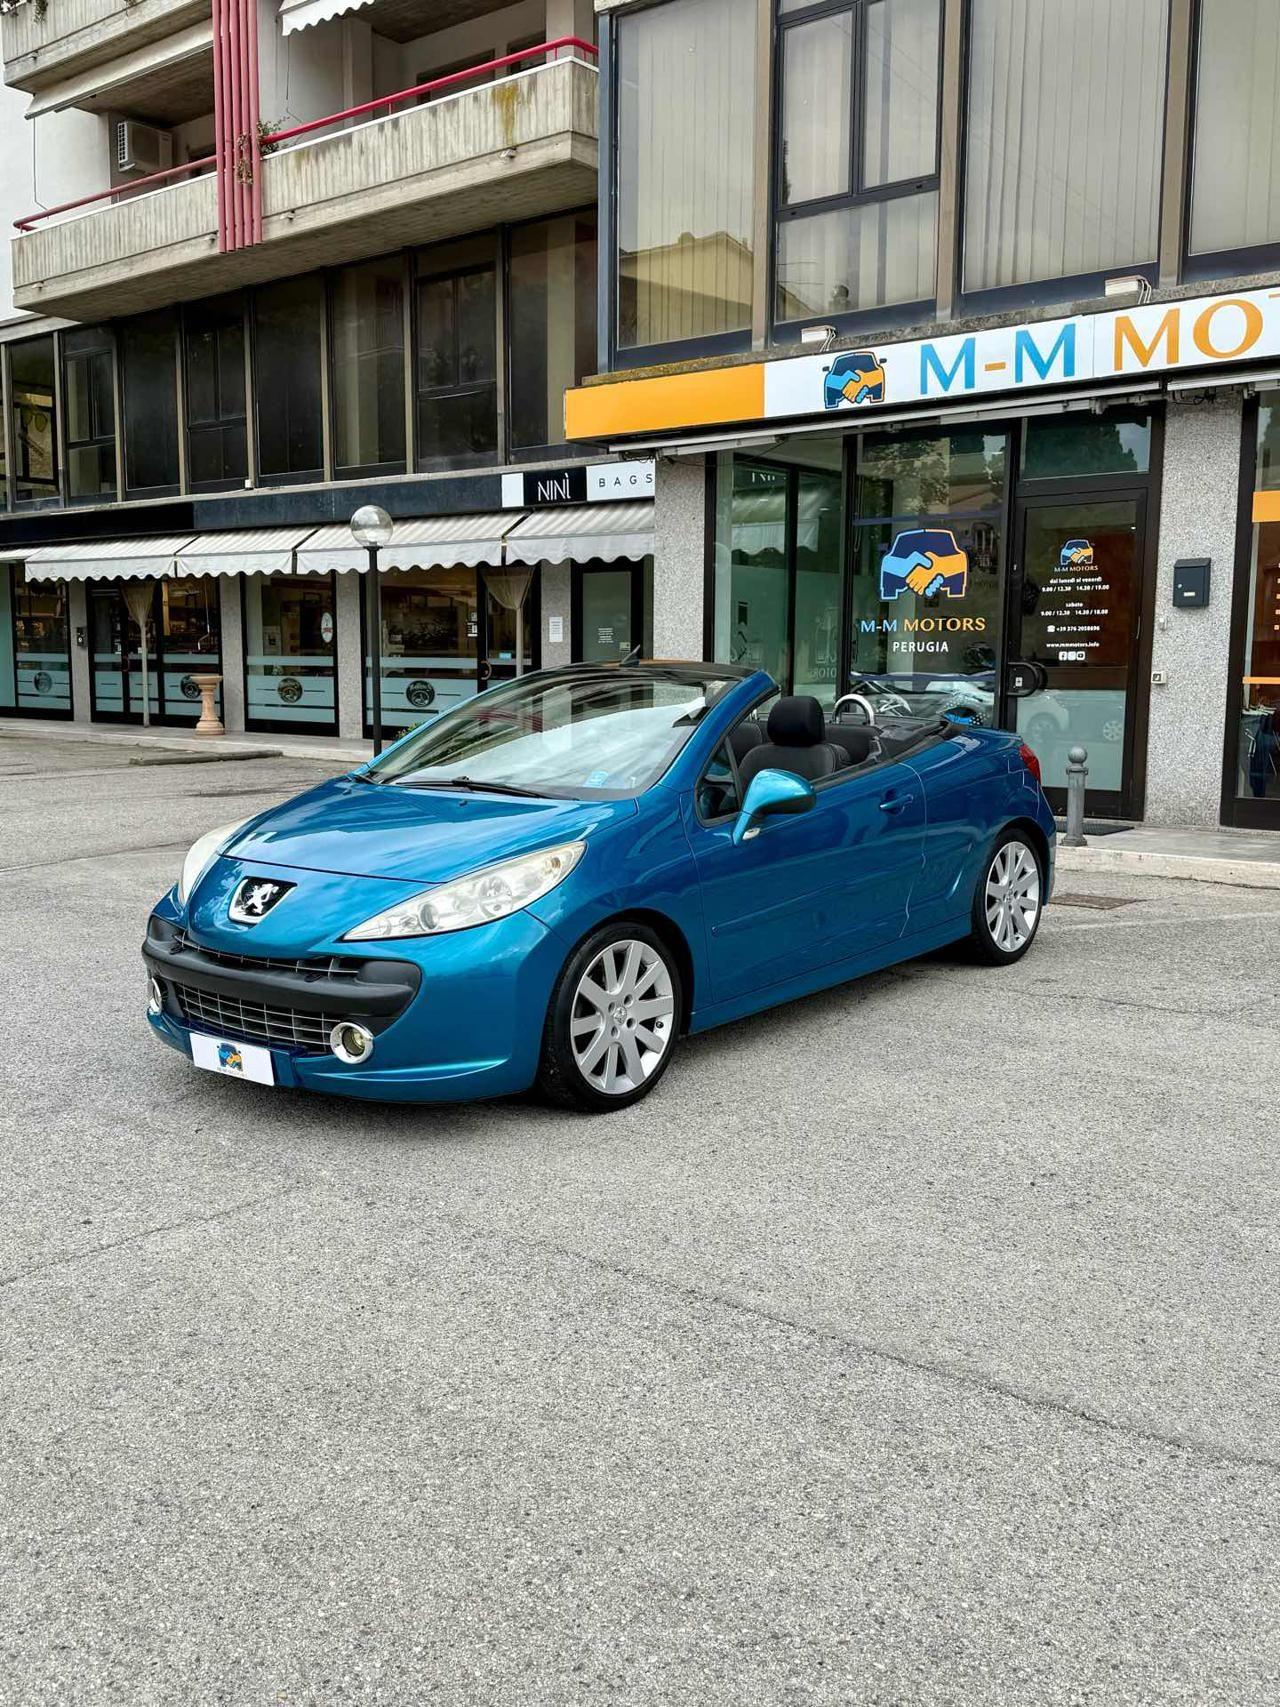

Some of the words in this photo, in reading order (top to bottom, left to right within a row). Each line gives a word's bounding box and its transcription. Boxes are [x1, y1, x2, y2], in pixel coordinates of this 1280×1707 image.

[920, 323, 1076, 395] M-M
[1114, 293, 1280, 371] MO
[599, 473, 653, 488] BAGS
[860, 619, 897, 633] M-M
[903, 617, 986, 632] MOTORS
[892, 641, 949, 653] PERUGIA
